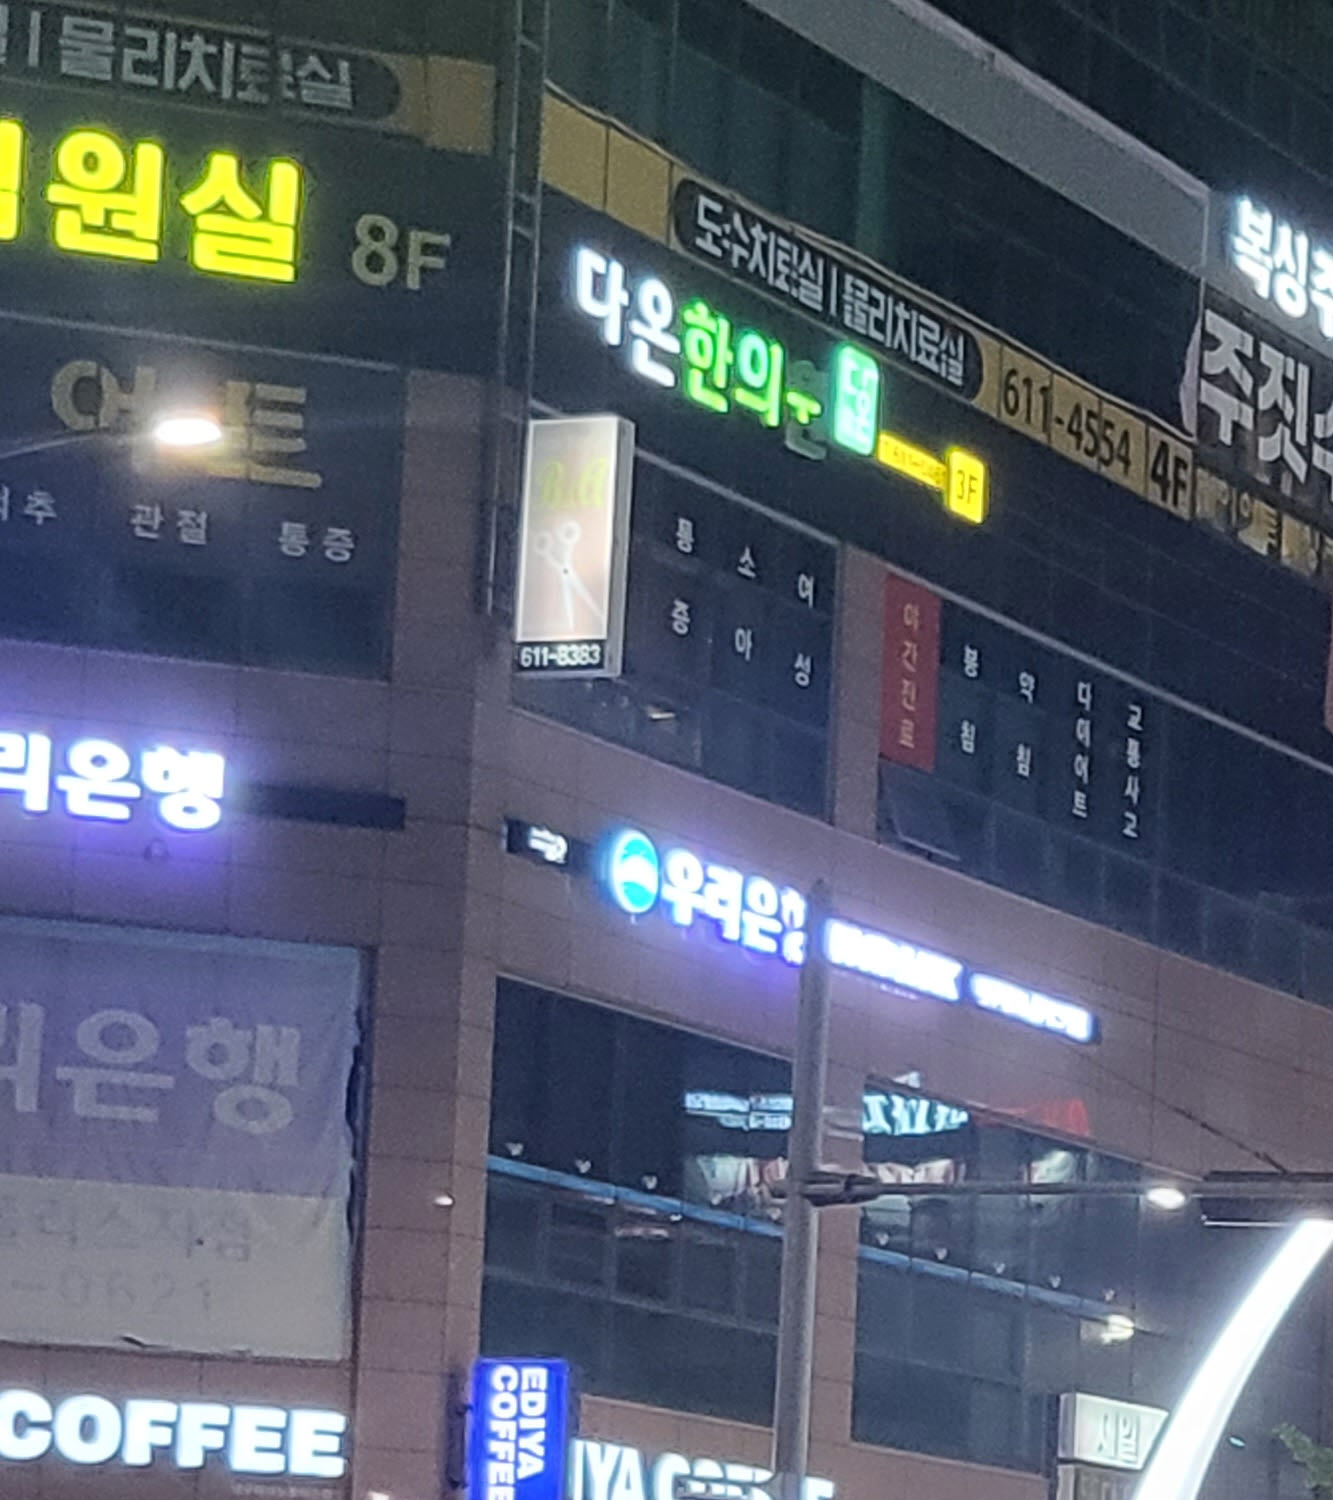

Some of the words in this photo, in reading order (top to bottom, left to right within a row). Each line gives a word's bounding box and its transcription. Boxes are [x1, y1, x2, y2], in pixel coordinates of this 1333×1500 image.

[350, 212, 453, 290] 8F
[955, 468, 981, 506] 3F
[1001, 365, 1133, 490] 611-4554
[1150, 438, 1193, 509] 4F
[128, 502, 209, 546] 관절
[277, 520, 356, 563] 통증
[670, 516, 694, 636] 통증
[733, 546, 757, 661] 소아
[1121, 704, 1145, 839] 교통사고
[0, 1388, 348, 1479] COFFEE
[516, 1365, 549, 1482] EDIYA
